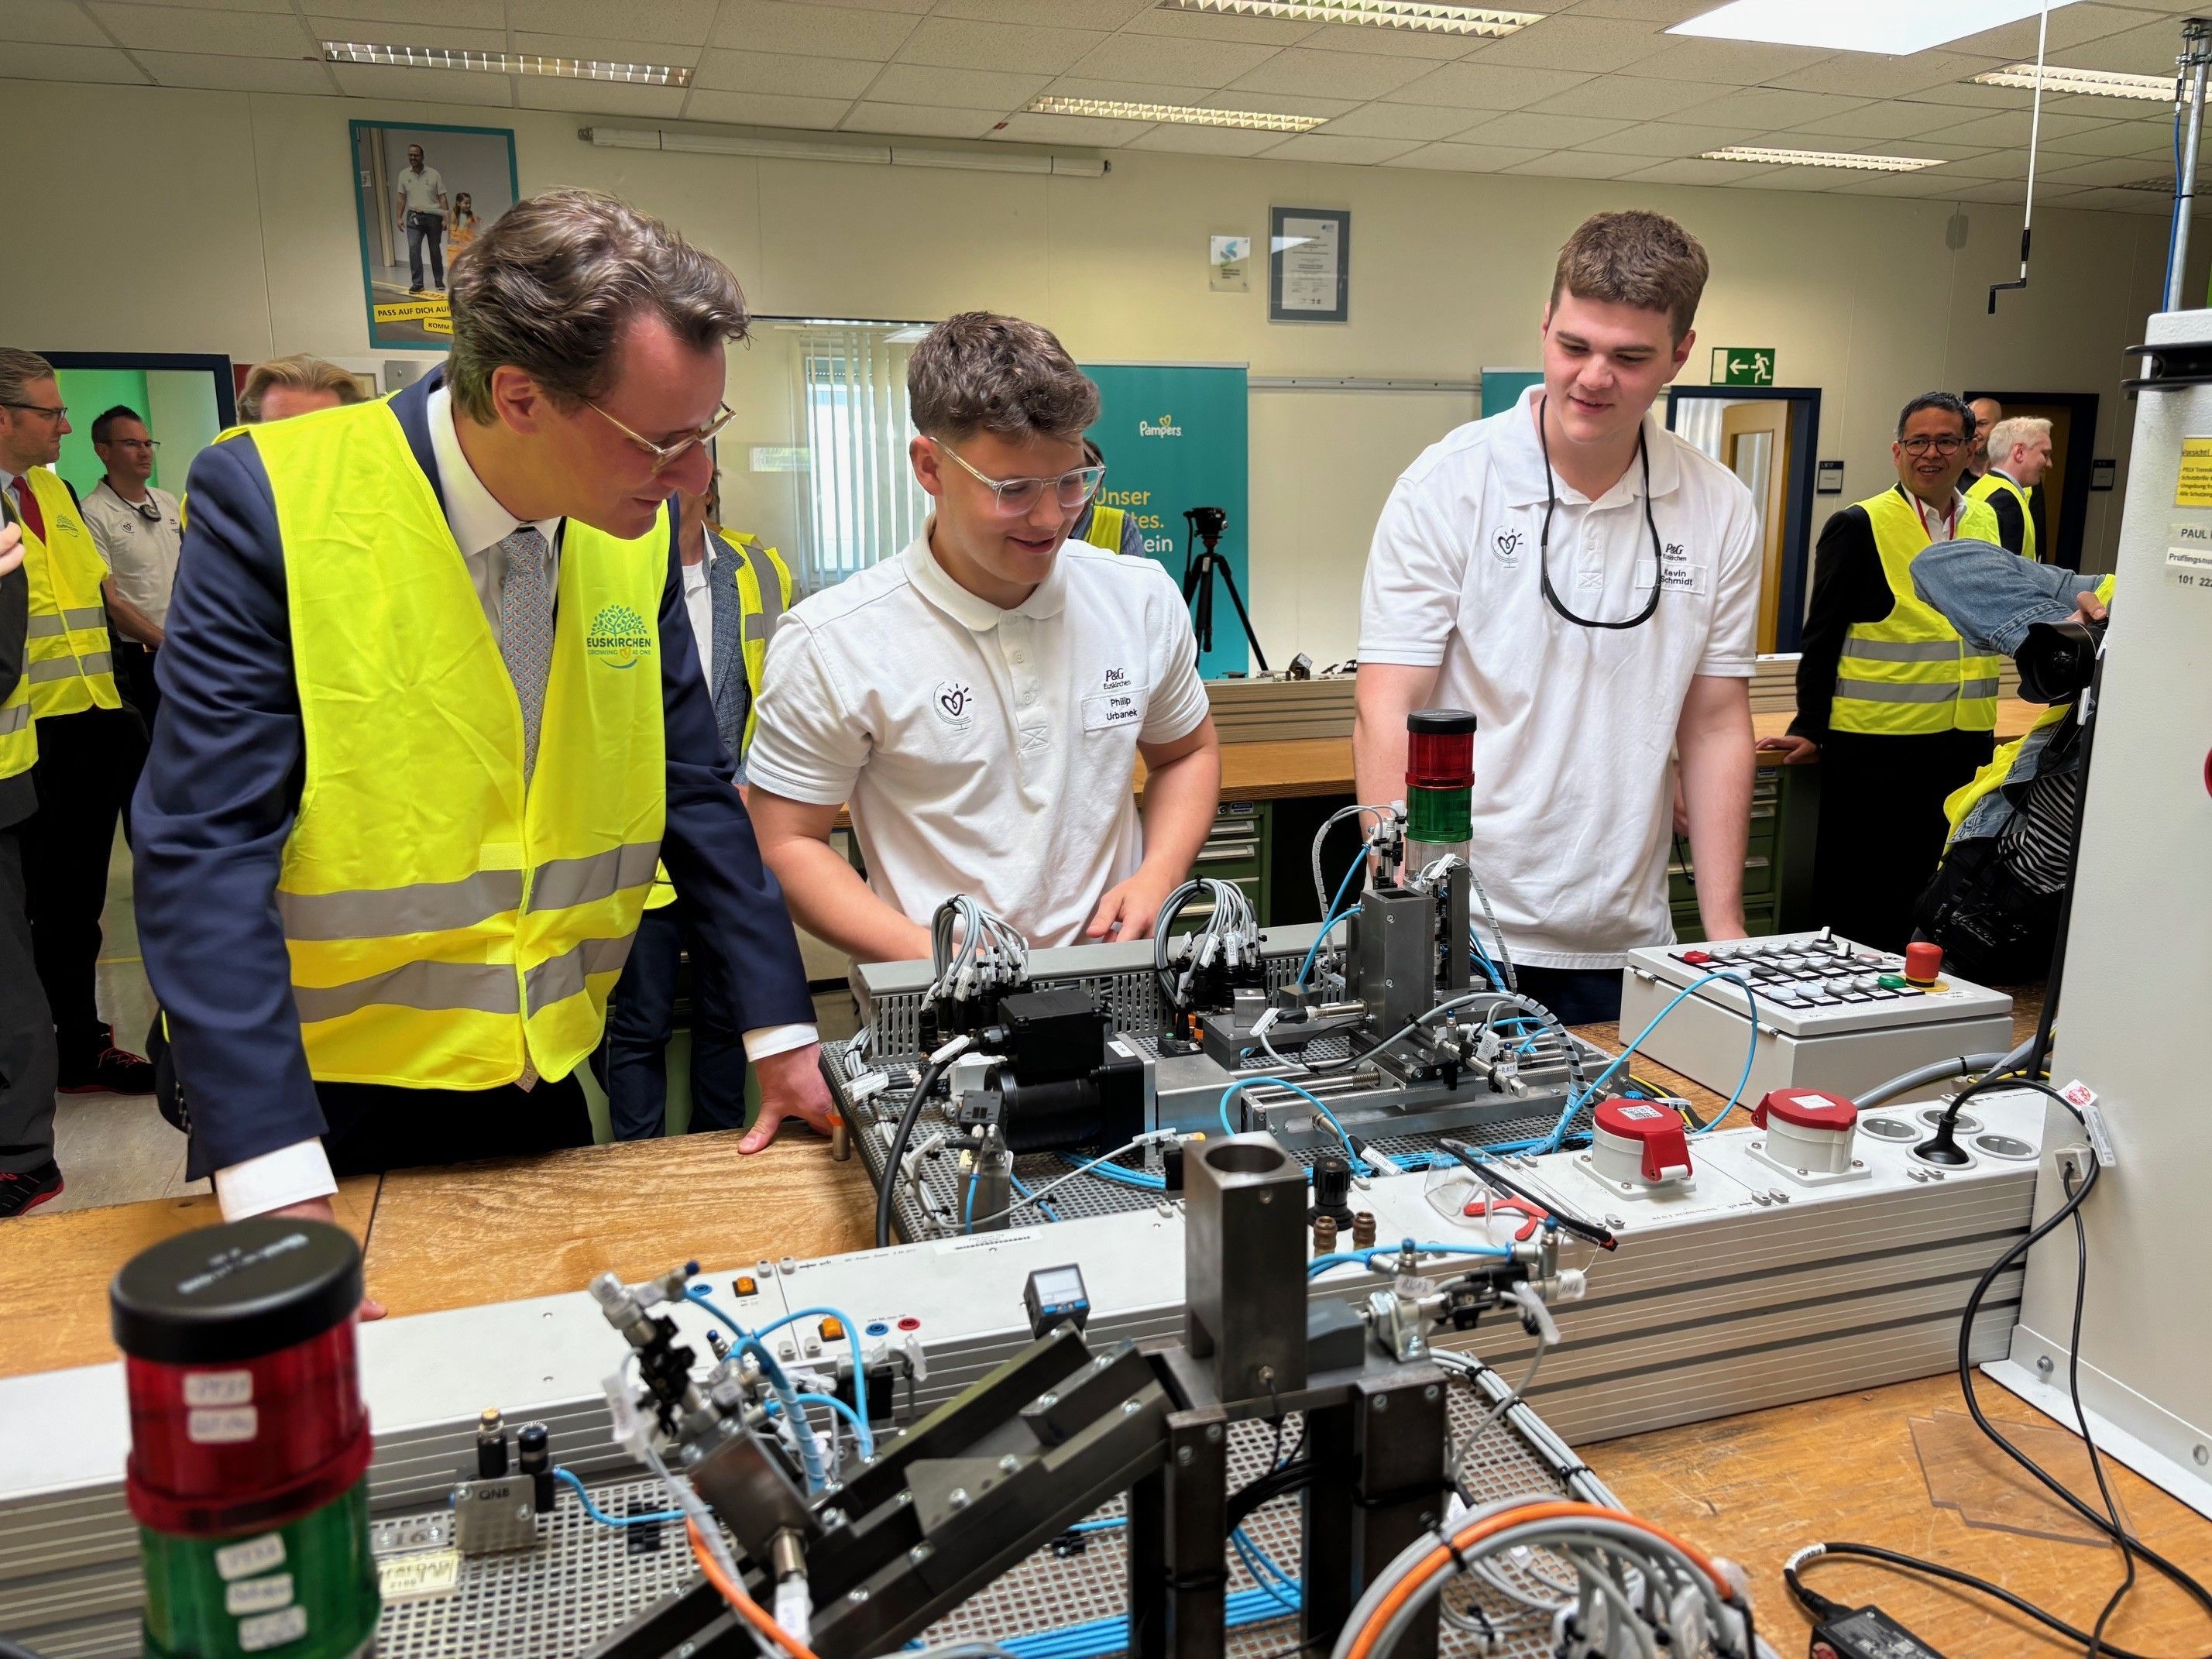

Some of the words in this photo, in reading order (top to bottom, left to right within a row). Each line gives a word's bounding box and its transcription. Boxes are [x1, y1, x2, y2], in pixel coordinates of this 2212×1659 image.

[1140, 421, 1183, 438] Pampers
[1094, 487, 1151, 506] Unser
[2181, 528, 2207, 539] PAUL
[1665, 543, 1684, 555] P&G
[1661, 575, 1693, 586] Schmidt
[2179, 575, 2193, 585] 101
[586, 637, 651, 647] EUSKIRCHEN
[1106, 668, 1124, 682] P&G
[1104, 680, 1132, 690] Euskirchen
[1110, 697, 1132, 707] Philip
[1107, 709, 1138, 721] Urbanek
